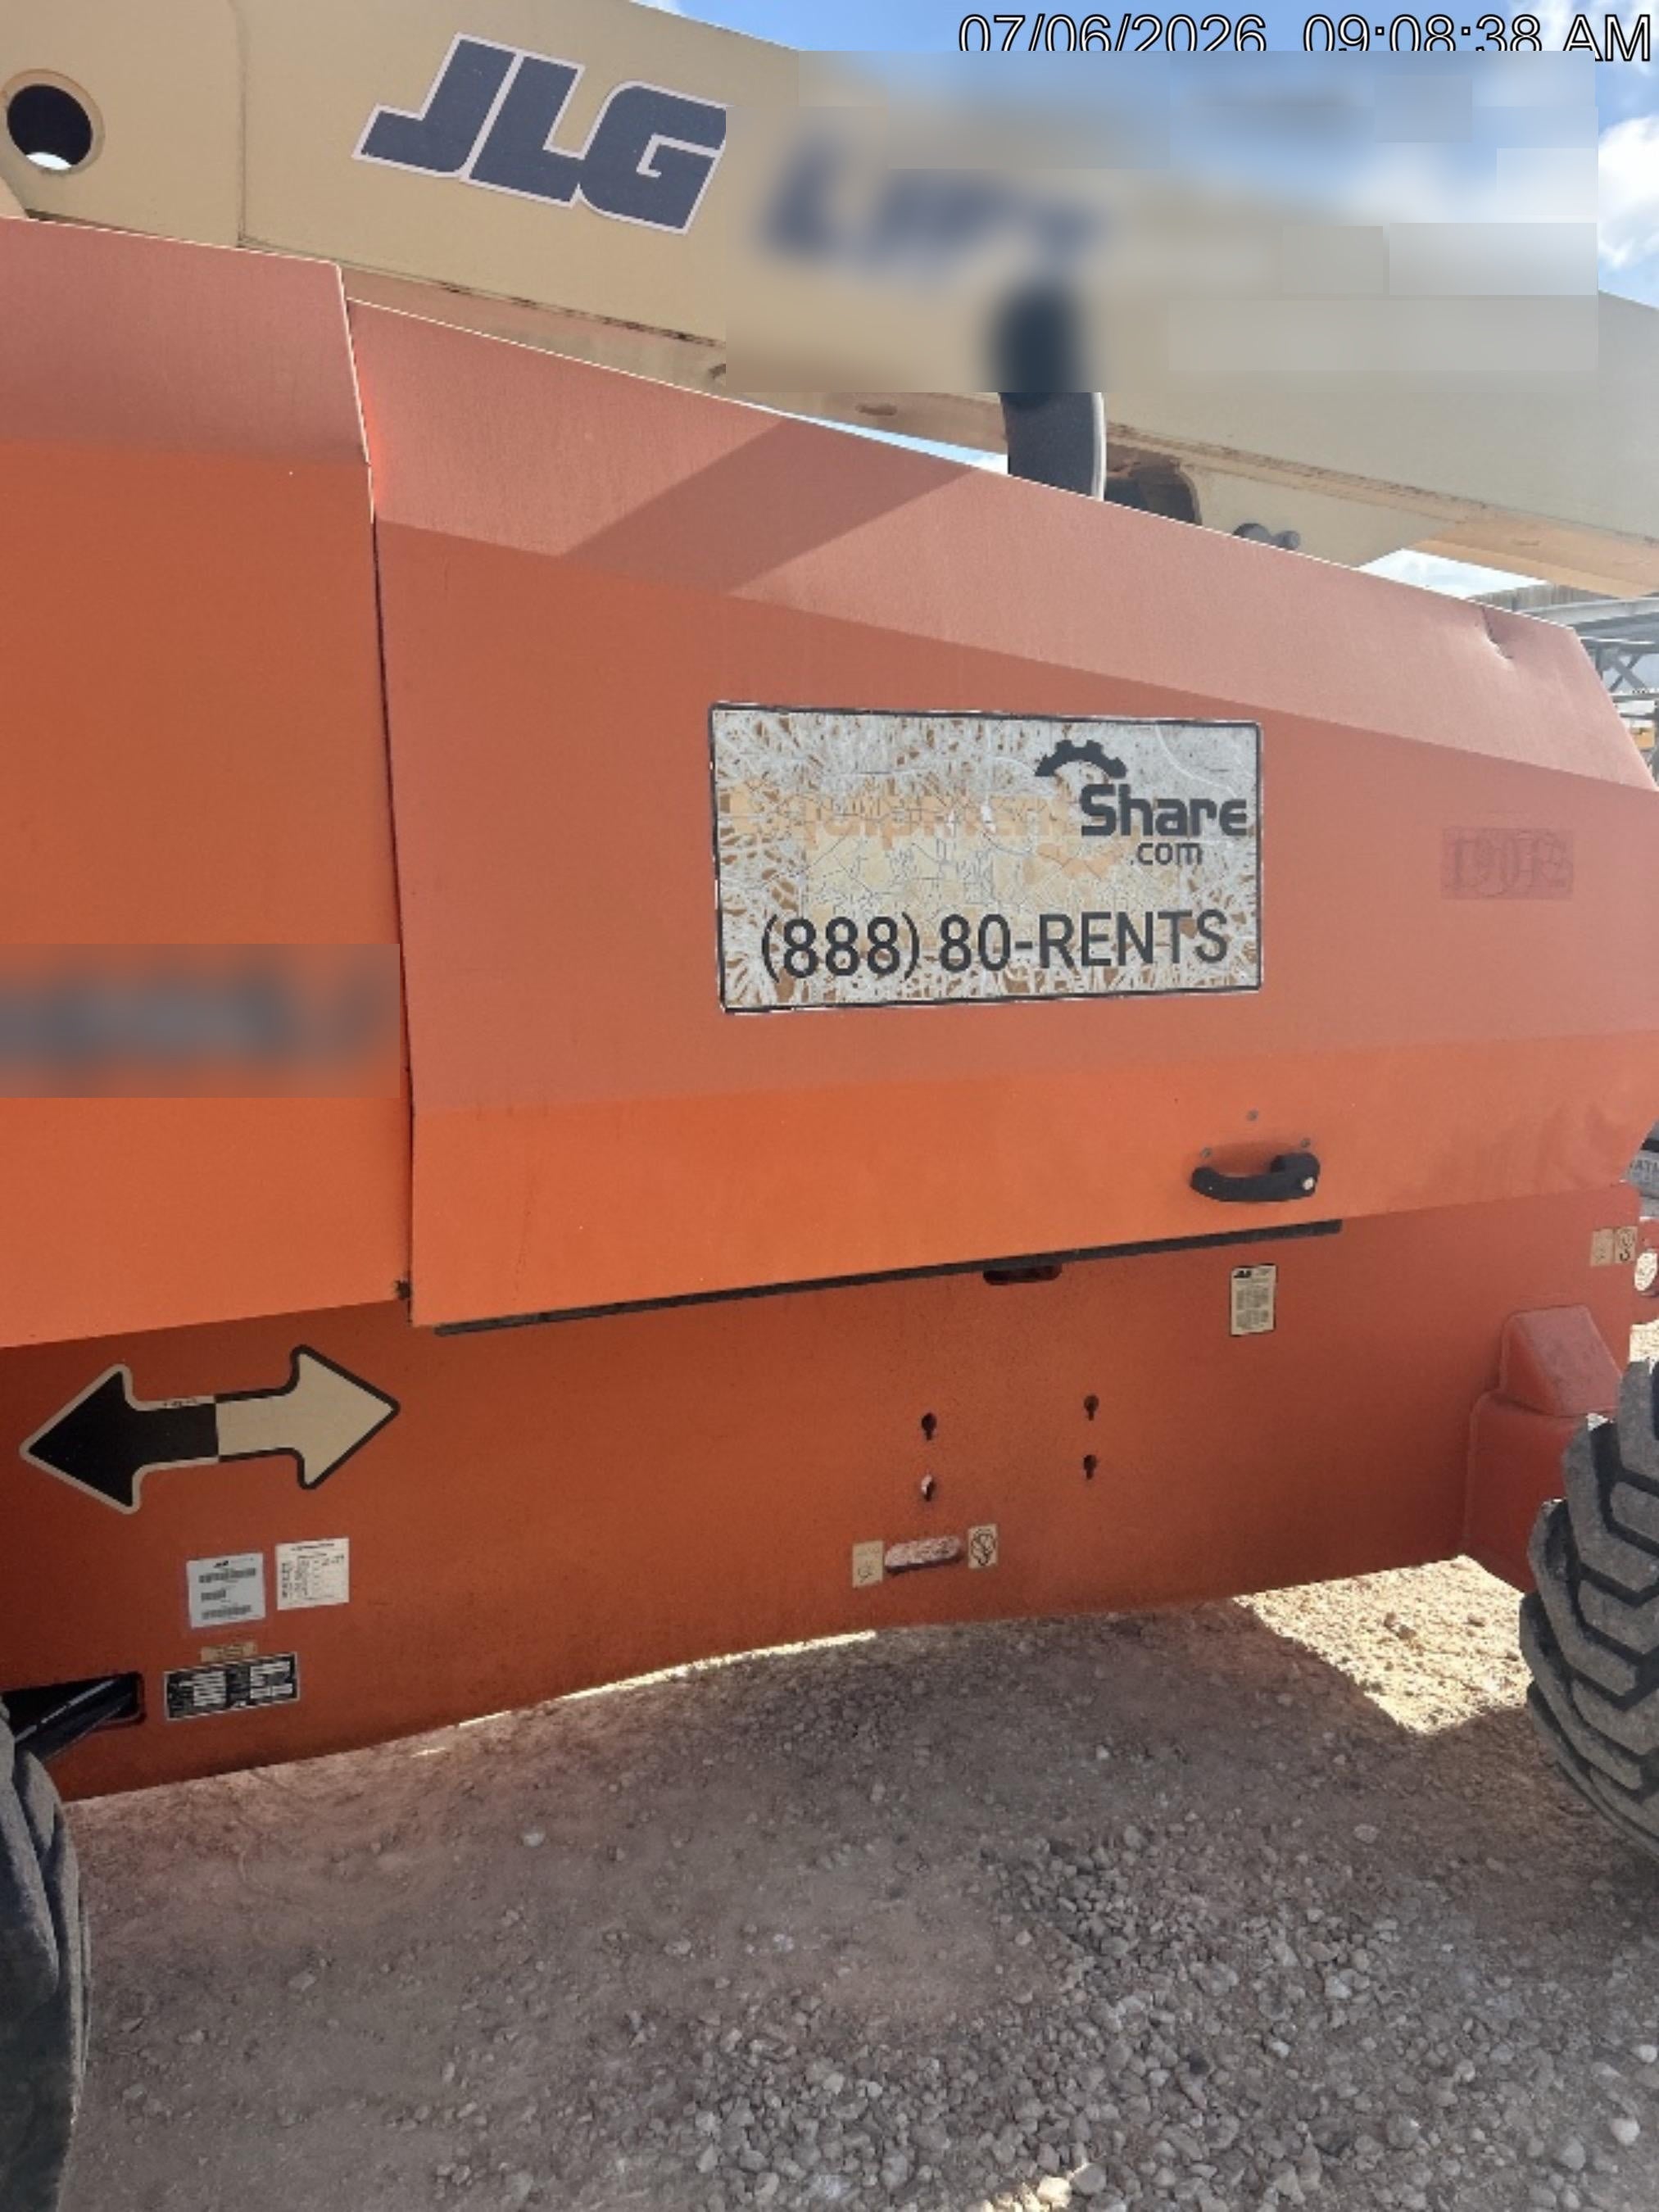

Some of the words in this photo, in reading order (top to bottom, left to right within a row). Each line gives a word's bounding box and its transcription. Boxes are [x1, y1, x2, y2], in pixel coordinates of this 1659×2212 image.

[355, 34, 727, 233] JLG
[1079, 783, 1247, 836] Share
[761, 912, 921, 982] (888)
[940, 909, 1228, 973] 80-RENTS
